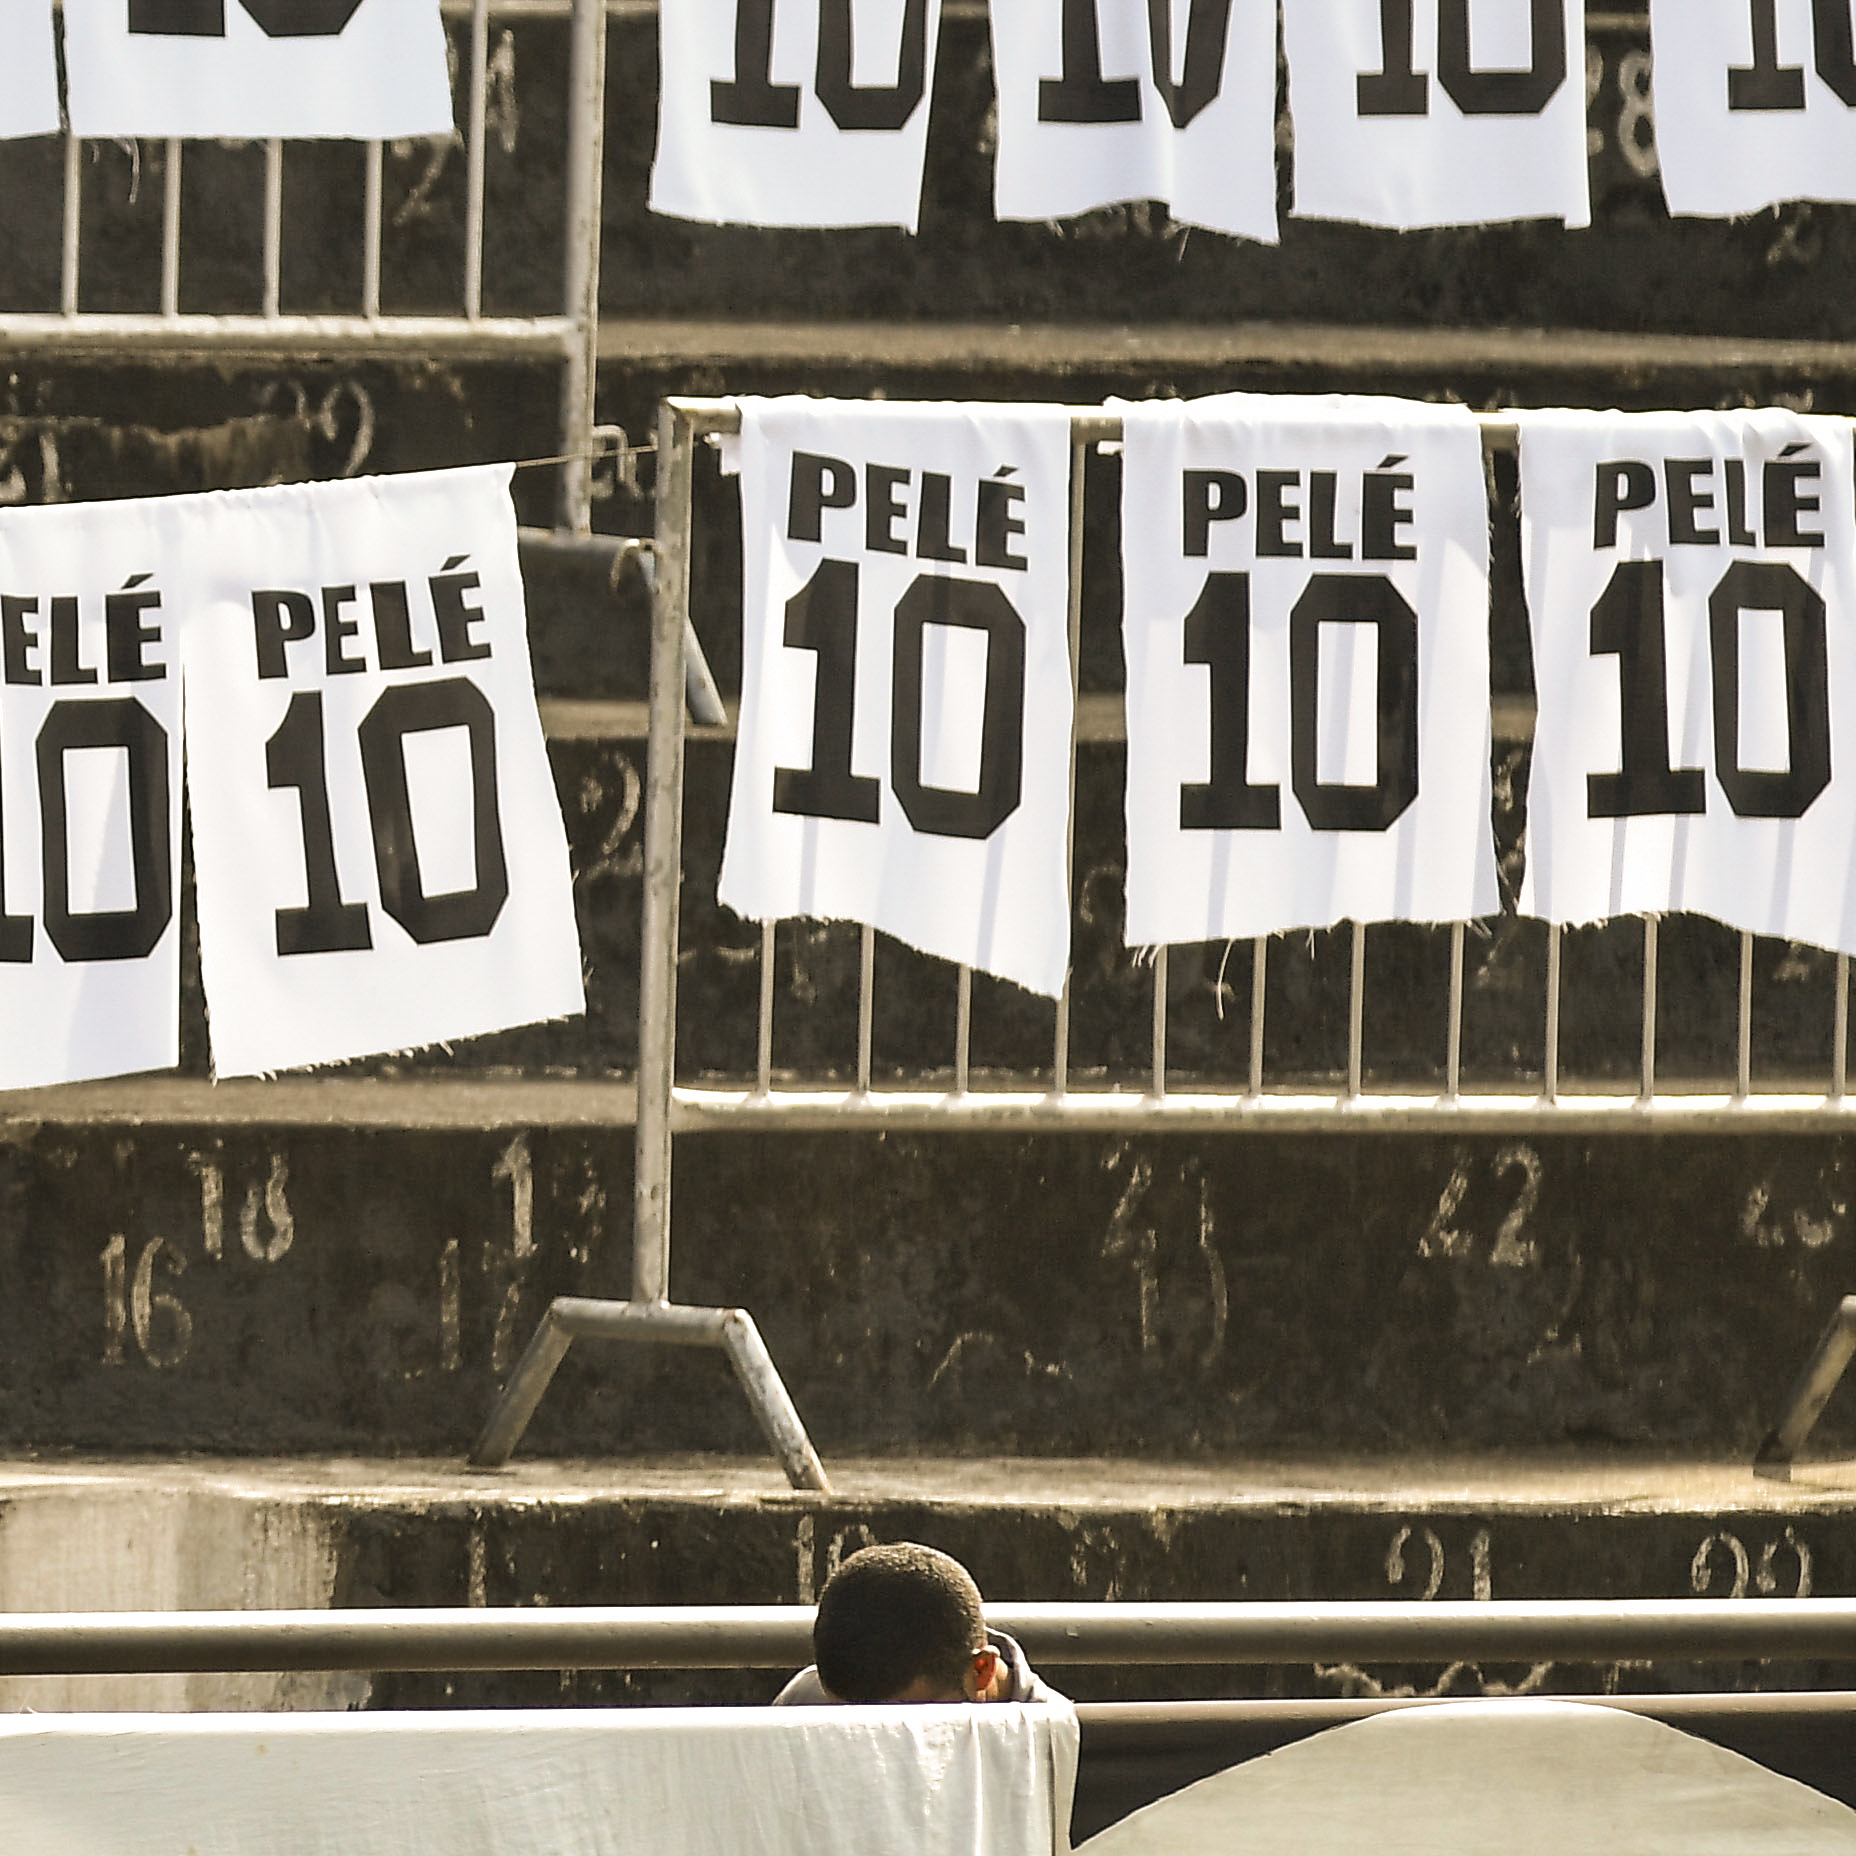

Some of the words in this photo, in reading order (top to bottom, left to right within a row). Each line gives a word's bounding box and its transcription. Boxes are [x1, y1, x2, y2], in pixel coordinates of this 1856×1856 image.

[786, 450, 1029, 573] PELÉ
[1181, 454, 1418, 562] PELÉ
[1592, 442, 1827, 551] PELÉ
[250, 553, 495, 682] PELÉ
[771, 557, 1028, 842] 10
[1178, 570, 1420, 833] 10
[1585, 558, 1833, 821] 10
[264, 679, 511, 959] 10
